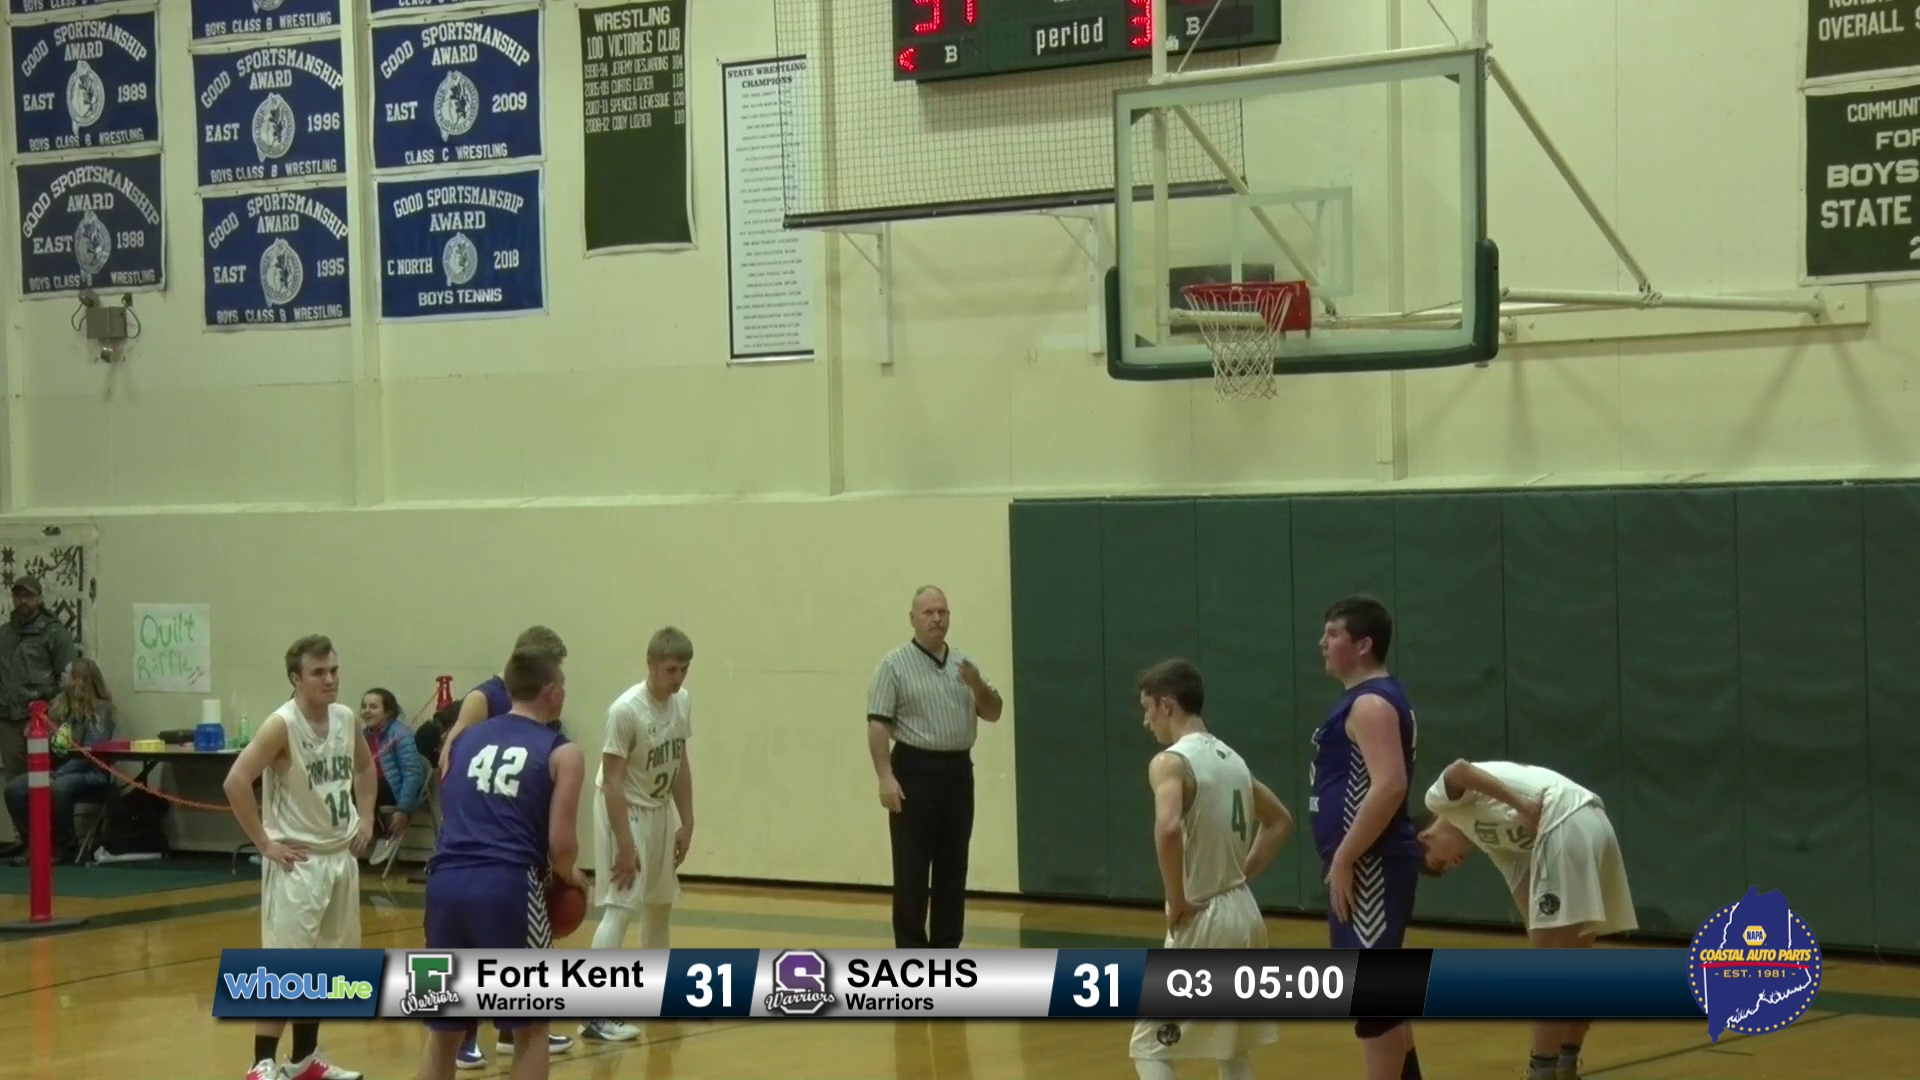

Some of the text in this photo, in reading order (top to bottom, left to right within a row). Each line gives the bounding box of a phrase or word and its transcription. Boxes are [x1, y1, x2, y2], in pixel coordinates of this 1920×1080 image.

[205, 23, 226, 37] BOYS
[232, 19, 261, 33] CLASS
[279, 11, 332, 29] WRESTLING
[594, 6, 670, 32] WRESTLING
[1186, 16, 1200, 36] B
[1819, 9, 1904, 41] OVERALL
[587, 27, 680, 60] 100 VICTORIES CLUB
[1036, 16, 1103, 56] period
[21, 20, 147, 77] GOOD SPORTSMANSHIP
[64, 41, 103, 61] AWARD
[381, 21, 530, 80] GOOD SPORTSMANSHIP
[432, 43, 478, 66] AWARD
[945, 45, 958, 63] B
[201, 48, 343, 109] GOOD SPORTSMANSHIP
[249, 69, 292, 91] AWARD
[727, 62, 807, 78] STATE WRESTLING
[117, 83, 147, 102] 1989
[742, 75, 793, 89] CHAMPIONS
[23, 93, 55, 111] EAST
[385, 101, 418, 122] EAST
[492, 92, 528, 113] 2009
[1847, 97, 1920, 122] COMMUNI
[205, 123, 240, 143] EAST
[307, 112, 340, 132] 1996
[29, 138, 49, 151] BOYS
[56, 135, 79, 148] CLASS
[100, 128, 144, 145] WRESTLING
[405, 143, 508, 165] CLASS C WRESTLING
[210, 159, 337, 183] BOYS CLASS B WRESTLING
[1827, 159, 1919, 189] BOYS
[23, 165, 160, 238] GOOD SPORTSMANSHIP
[67, 192, 114, 212] AWARD
[393, 186, 524, 218] GOOD SPORTSMANSHIP
[1821, 195, 1912, 229] STATE
[208, 193, 349, 249] GOOD SPORTSMANSHIP
[257, 213, 299, 234] AWARD
[430, 210, 486, 232] AWARD
[33, 236, 73, 254] EAST
[117, 231, 144, 248] 1988
[316, 257, 344, 277] 1995
[387, 257, 433, 275] C NORTH
[494, 249, 519, 269] 2018
[29, 276, 50, 290] BOYS
[53, 275, 80, 288] CLASS
[111, 269, 155, 284] WRESTLING
[213, 265, 246, 284] EAST
[418, 288, 503, 306] BOYS TENNIS
[216, 309, 239, 324] BOYS
[245, 308, 275, 323] CLASS
[293, 304, 342, 321] WRESTLING
[140, 612, 195, 649] Quilt
[466, 743, 529, 798] 42
[325, 789, 351, 827] 14
[1230, 788, 1248, 842] 4
